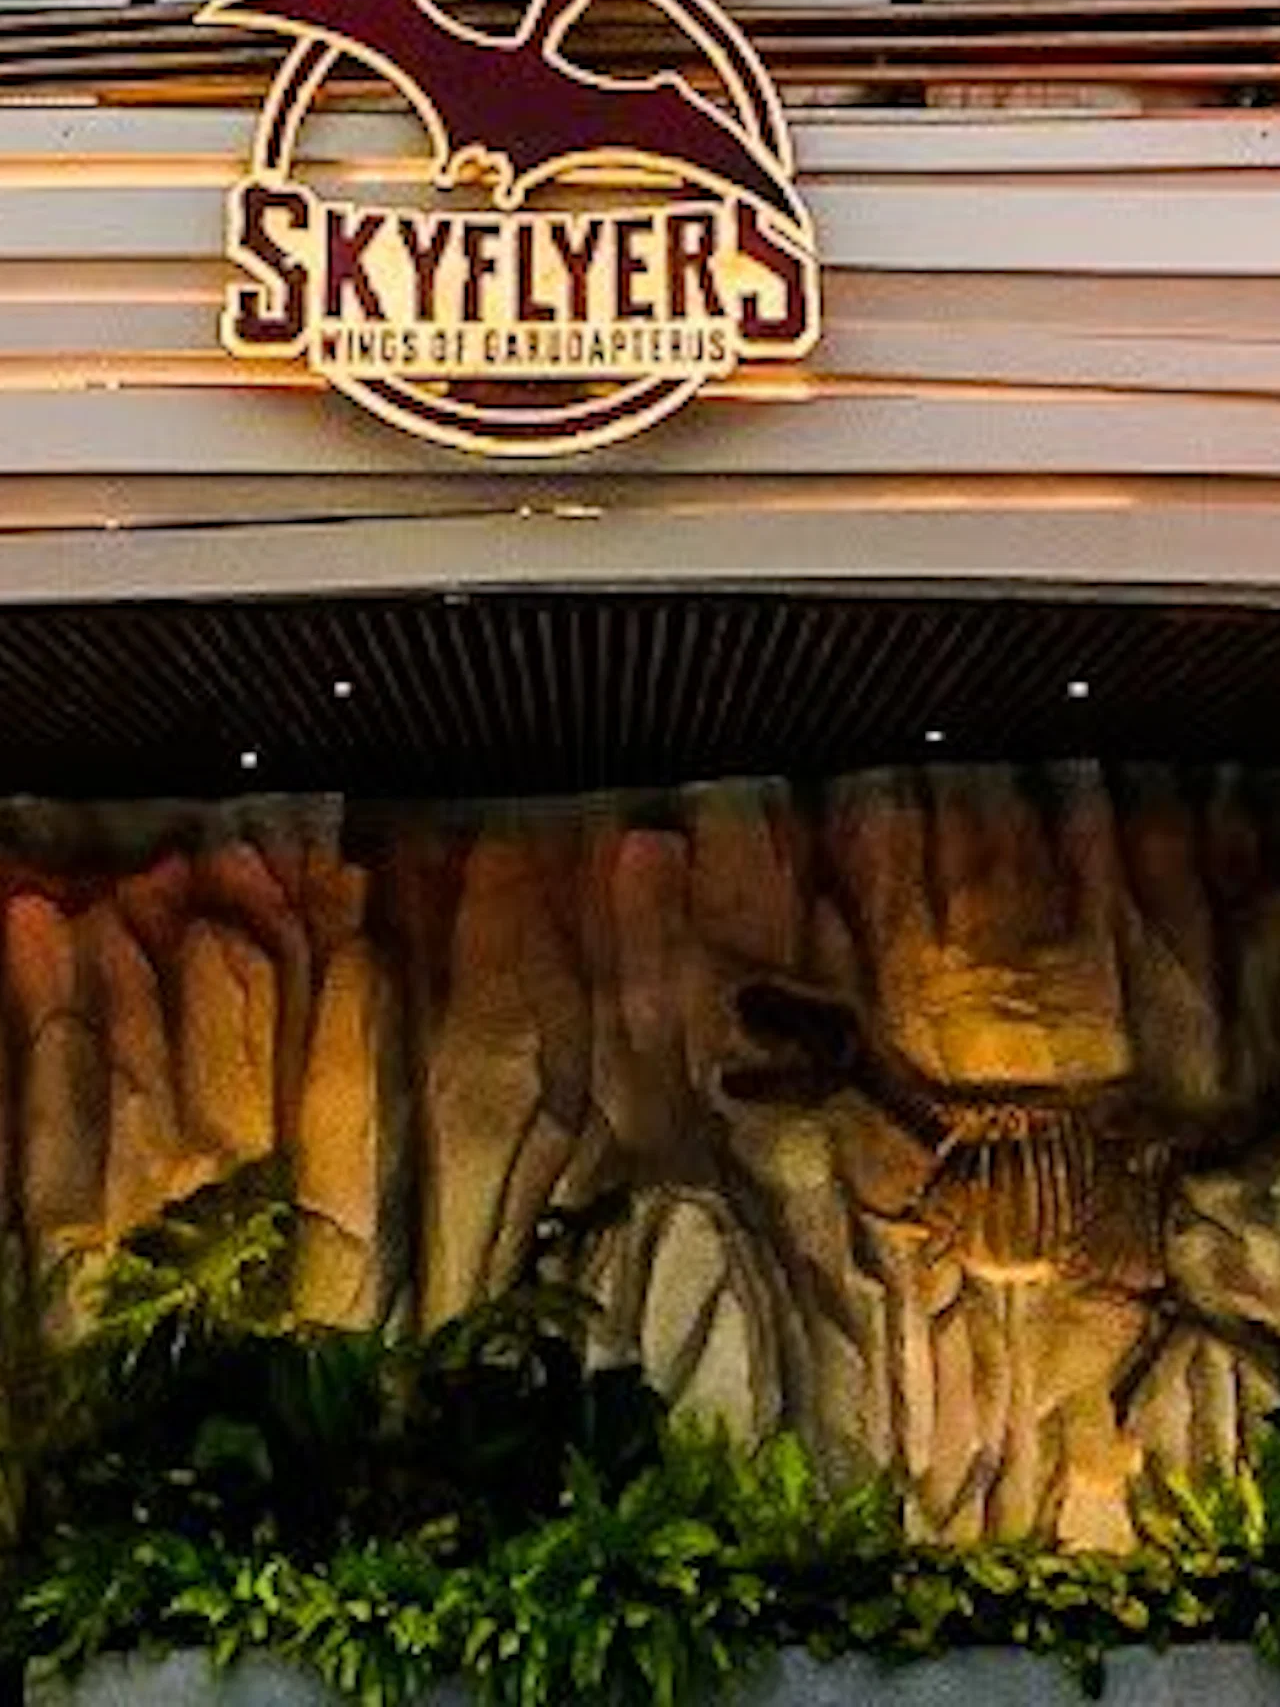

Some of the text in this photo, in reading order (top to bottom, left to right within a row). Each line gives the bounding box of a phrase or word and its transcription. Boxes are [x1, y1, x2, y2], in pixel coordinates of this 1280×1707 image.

[238, 187, 807, 343] SKYFLYERS
[319, 328, 419, 364] WINGS
[429, 328, 466, 364] OF
